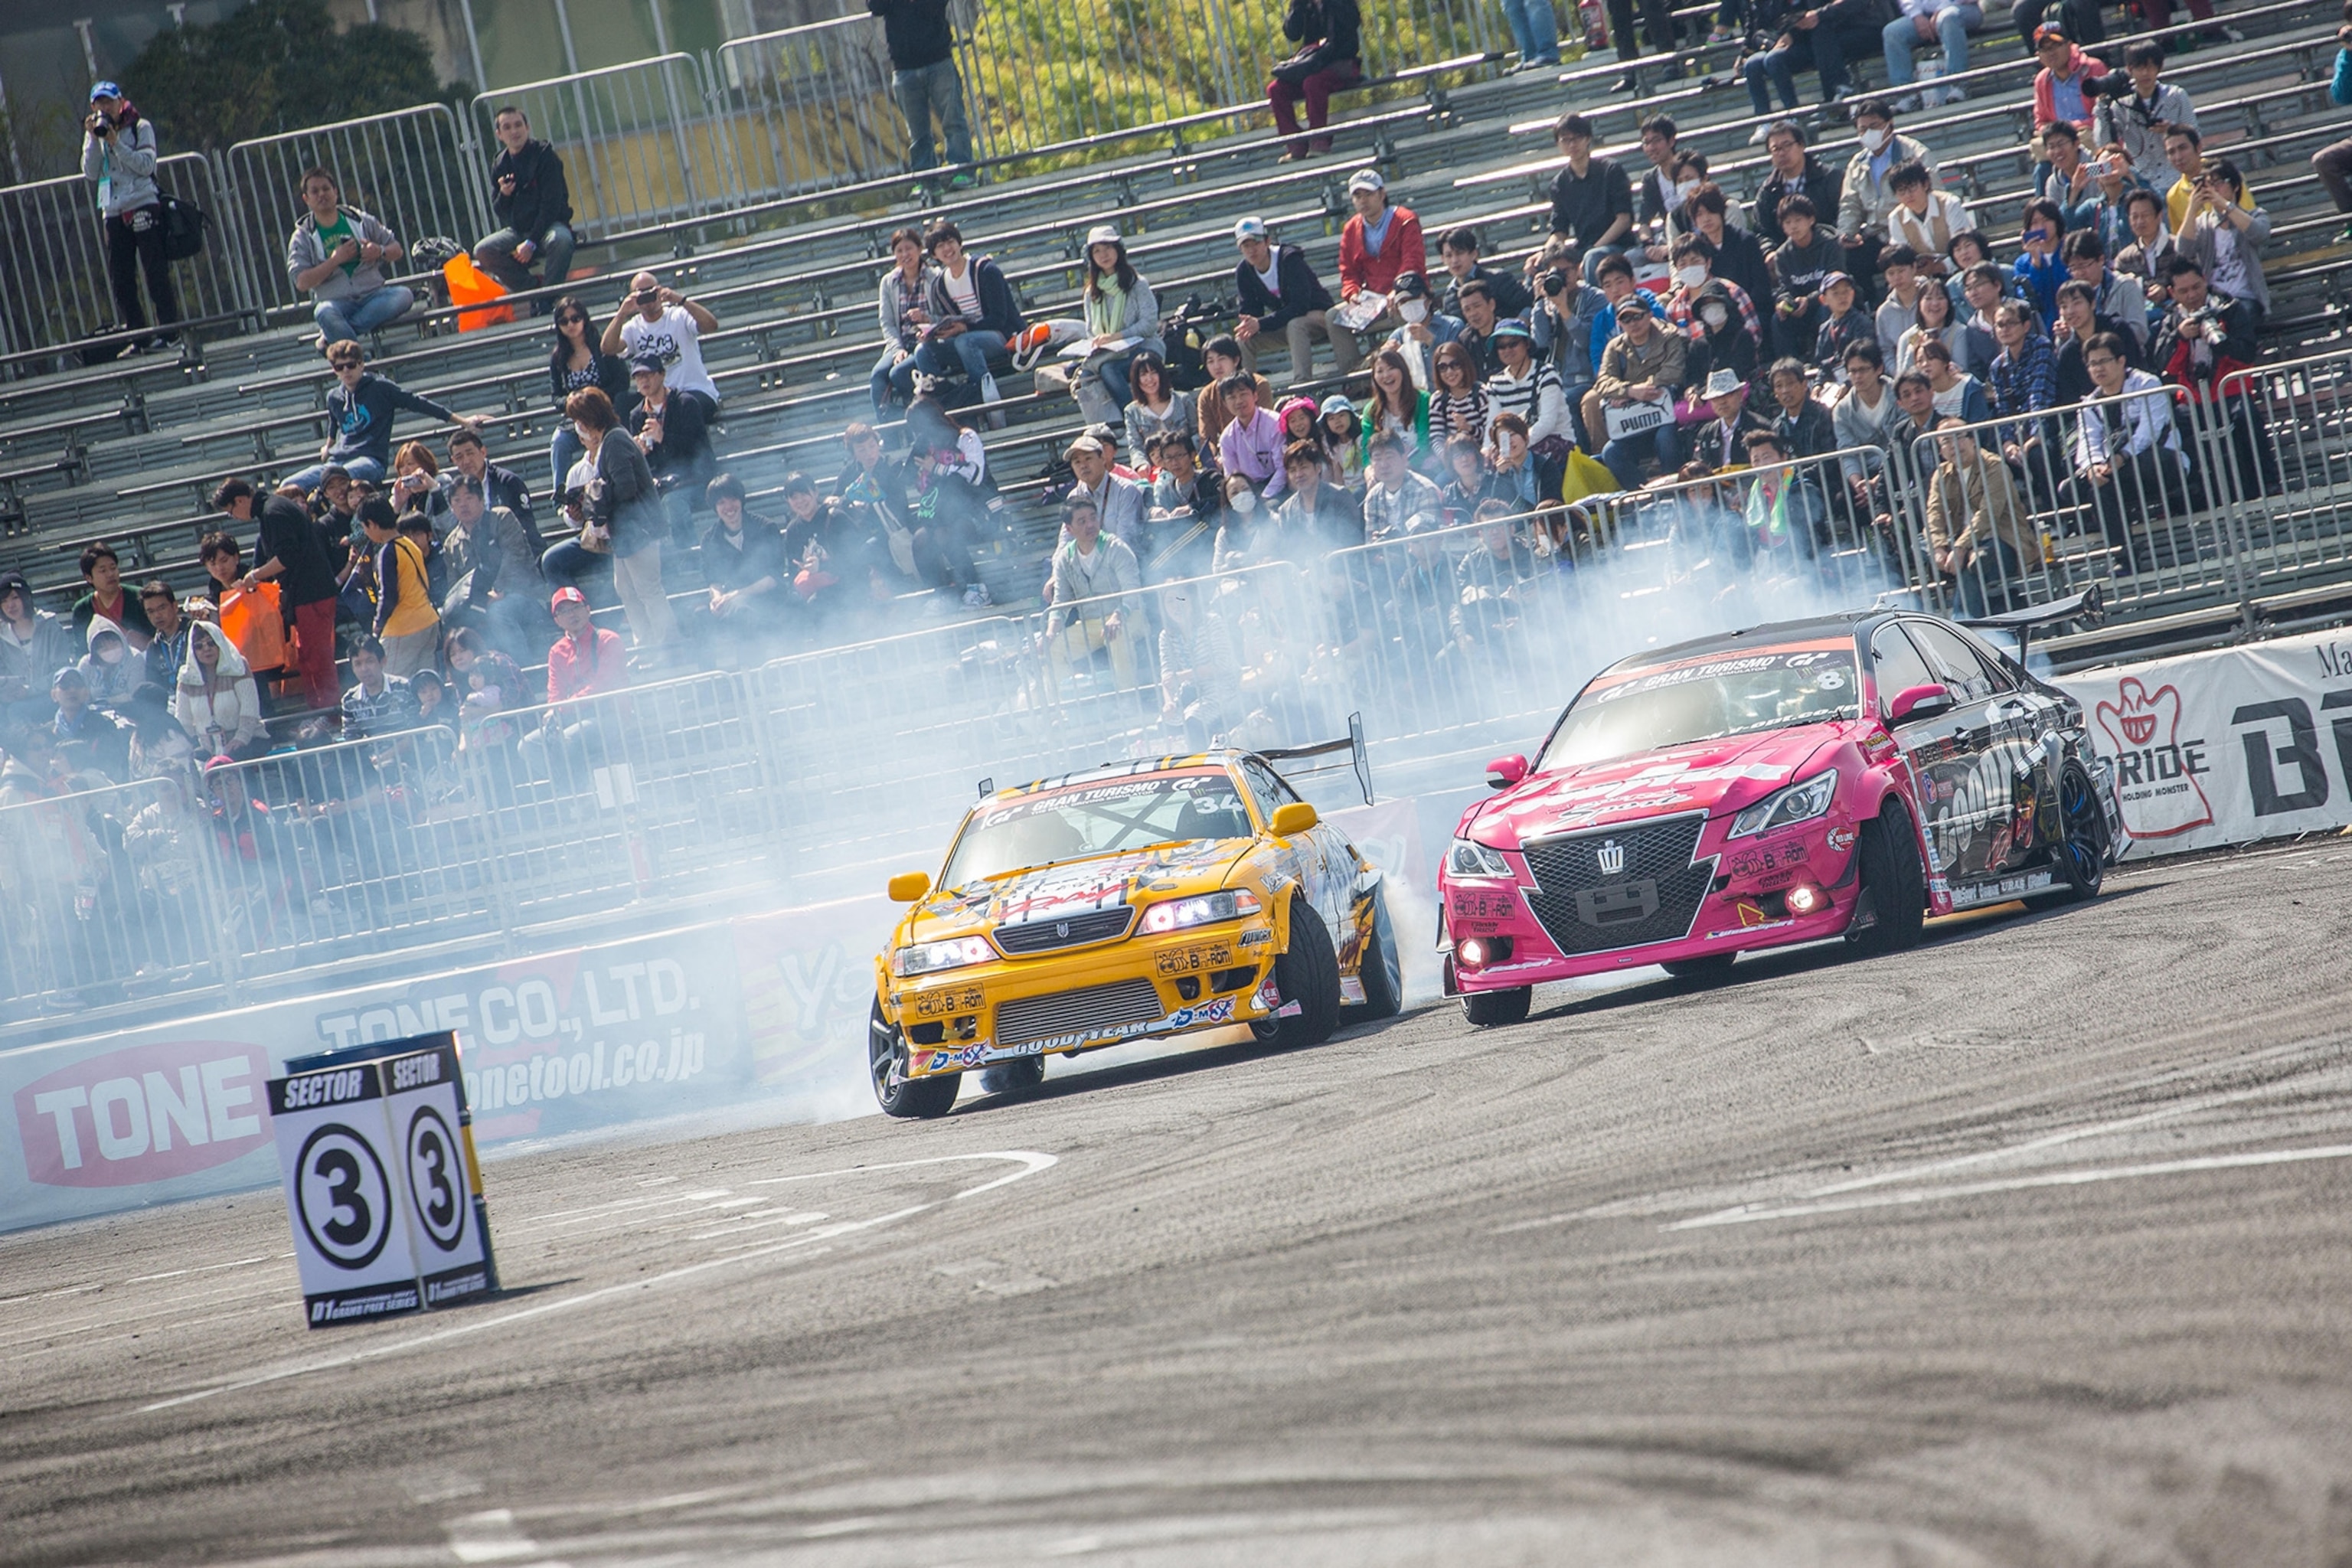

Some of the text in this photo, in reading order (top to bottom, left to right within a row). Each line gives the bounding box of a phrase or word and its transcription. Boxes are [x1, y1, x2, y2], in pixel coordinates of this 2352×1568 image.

[1620, 411, 1661, 433] PUMA
[1645, 668, 1695, 688] GRAN
[1699, 656, 1776, 675] TURISMO
[1817, 671, 1844, 690] 8
[1032, 792, 1083, 812] GRAN
[1085, 780, 1160, 801] TURISMO
[1194, 793, 1244, 815] 34
[2122, 782, 2190, 802] HOLDING MONSTER
[394, 1053, 440, 1089] SECTOR
[284, 1069, 363, 1109] SECTOR
[34, 1055, 261, 1170] TONE
[418, 1130, 454, 1228] 3
[315, 1148, 371, 1246] 3
[311, 1298, 335, 1322] D1
